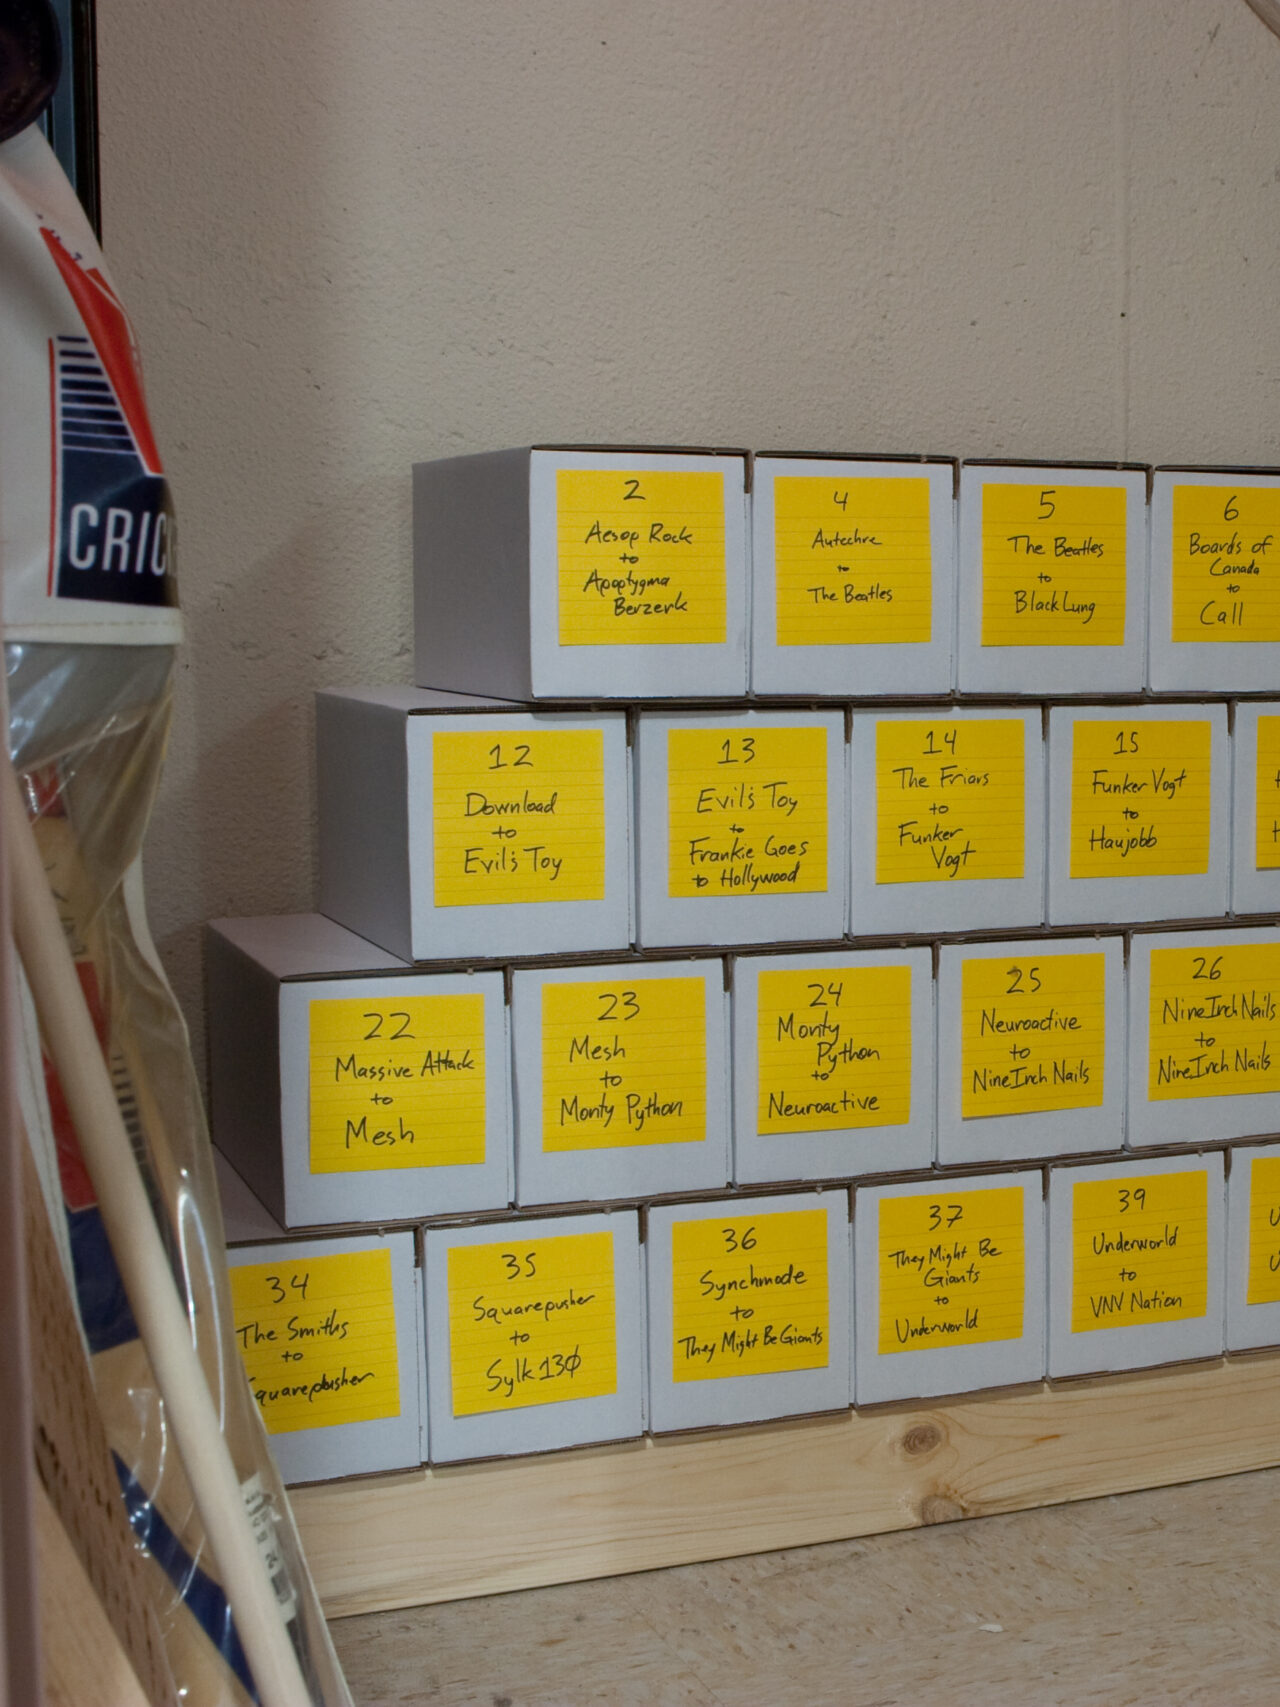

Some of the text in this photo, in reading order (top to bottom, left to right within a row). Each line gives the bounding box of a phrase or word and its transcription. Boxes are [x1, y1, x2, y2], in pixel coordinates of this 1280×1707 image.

[623, 479, 646, 501] 2
[833, 491, 849, 511] 4
[1038, 490, 1056, 520] 5
[1223, 495, 1239, 522] 6
[584, 520, 693, 549] Aesop Rock
[811, 528, 883, 549] Autechre
[1007, 534, 1104, 558] The Beatles
[1189, 531, 1274, 556] Boards of
[1209, 557, 1260, 577] Canada
[807, 583, 893, 604] The Beatles
[1199, 600, 1244, 625] Call
[489, 743, 533, 770] 12
[717, 737, 755, 765] 13
[922, 729, 957, 755] 14
[1113, 731, 1139, 755] 15
[892, 766, 929, 789] The
[1092, 767, 1187, 800] Funker Vogt
[464, 790, 558, 817] Download
[762, 781, 798, 817] Toy
[897, 820, 964, 846] Funker
[1088, 824, 1158, 858] Haujobb
[523, 846, 563, 881] Toy
[689, 835, 809, 866] Frankie Goes
[930, 840, 977, 878] Vogt
[720, 860, 801, 892] Hollywood
[1006, 966, 1042, 994] 25
[1192, 956, 1223, 981] 26
[597, 991, 640, 1021] 23
[807, 982, 843, 1008] 24
[1162, 990, 1276, 1025] Nine Nails
[363, 1012, 415, 1041] 22
[777, 1010, 840, 1045] Monty
[980, 1007, 1082, 1036] Neuroactive
[569, 1034, 626, 1063] Mesh
[815, 1038, 880, 1077] Python
[1157, 1040, 1271, 1085] Nine Nails
[335, 1053, 413, 1082] Massive
[973, 1059, 1090, 1094] Nine Nails
[560, 1091, 683, 1132] Monty Python
[768, 1090, 880, 1119] Neuroactive
[345, 1116, 415, 1149] Mesh
[1118, 1188, 1146, 1213] 39
[929, 1204, 963, 1231] 37
[722, 1226, 757, 1253] 36
[1092, 1224, 1179, 1255] Underworld
[501, 1252, 536, 1280] 35
[887, 1237, 1002, 1272] They Might Be
[265, 1273, 309, 1304] 34
[699, 1263, 807, 1301] Synchmode
[923, 1263, 980, 1288] Giants
[473, 1289, 595, 1325] Squarepusher
[1090, 1290, 1182, 1318] VNV Nation
[235, 1308, 349, 1349] The Smiths
[895, 1308, 979, 1344] Underworld
[677, 1324, 778, 1363] They Might Be
[486, 1357, 534, 1398] Sylk
